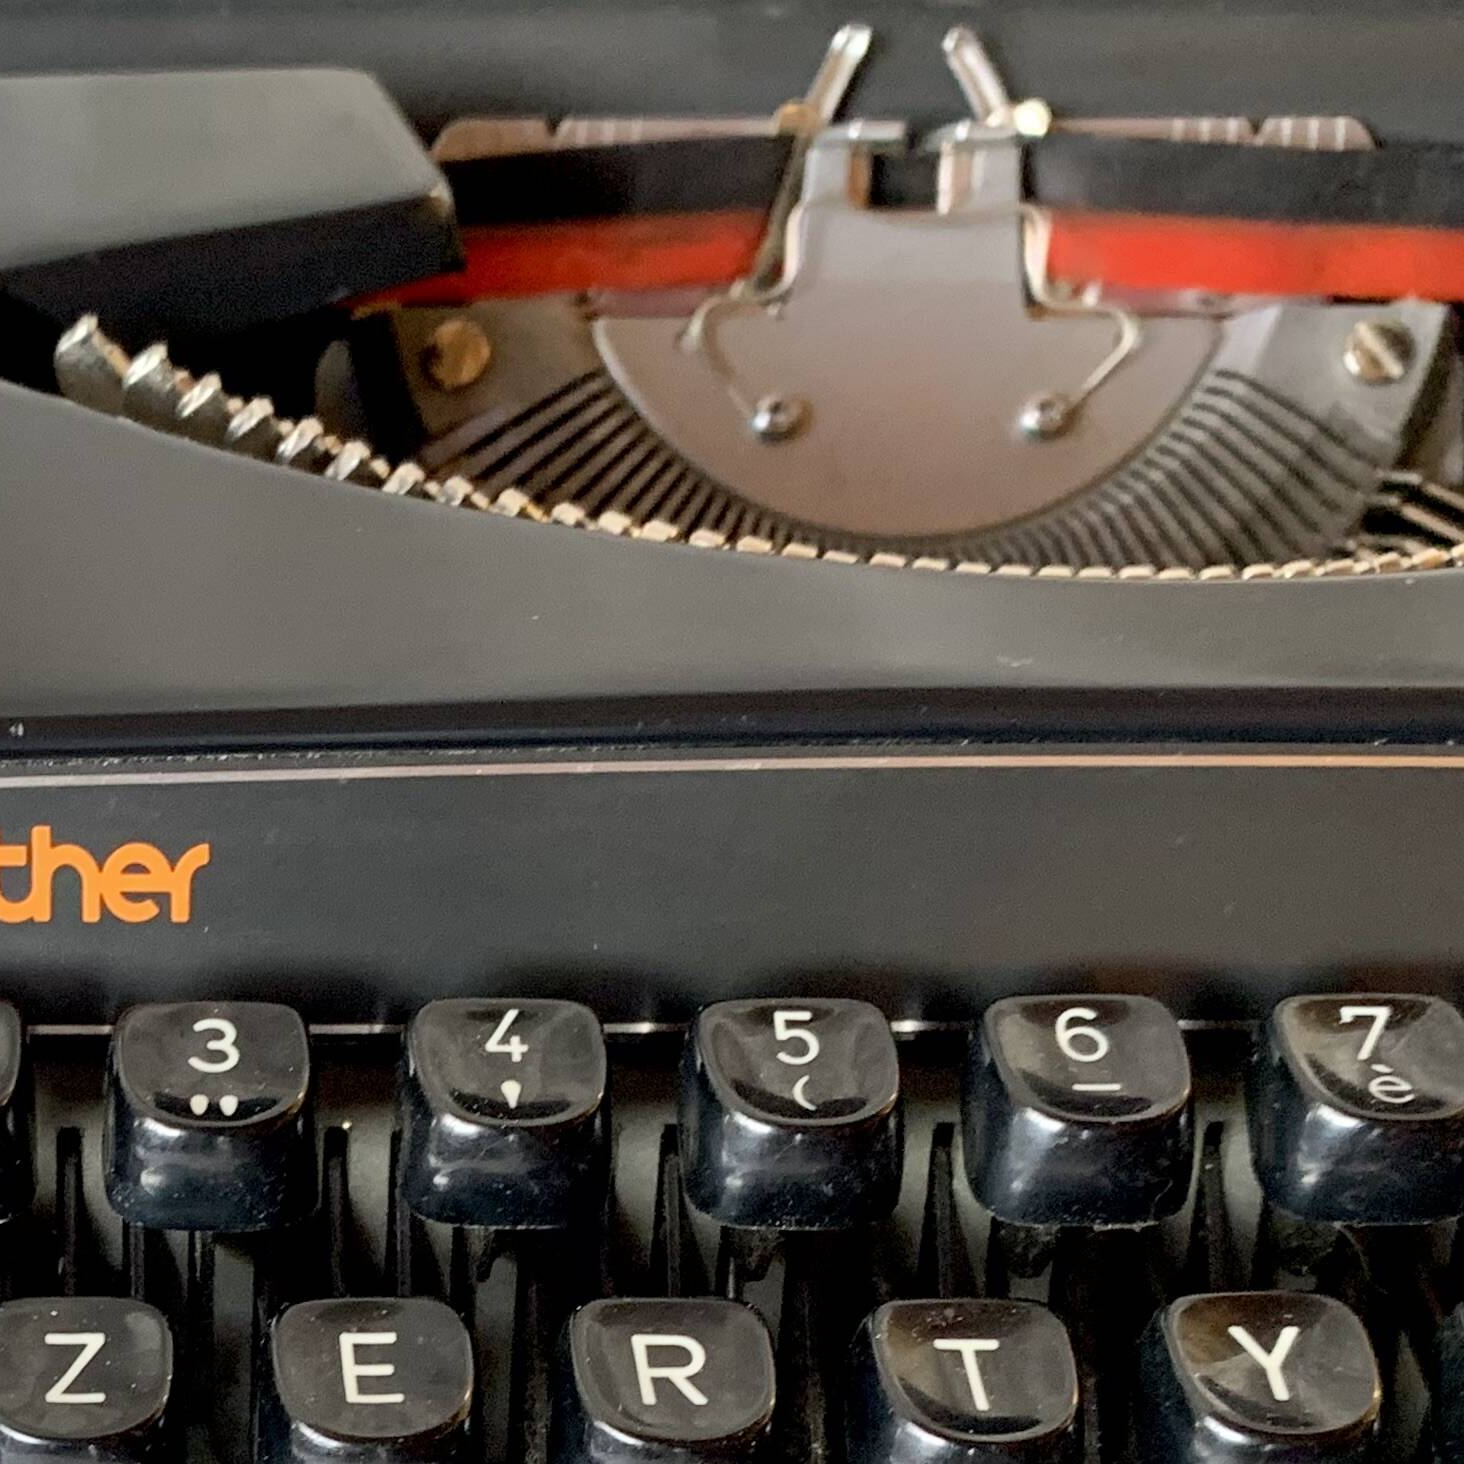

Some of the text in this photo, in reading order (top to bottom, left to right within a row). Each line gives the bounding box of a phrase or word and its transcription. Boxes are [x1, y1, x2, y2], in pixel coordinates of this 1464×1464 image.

[187, 1018, 240, 1072] 3
[484, 1009, 529, 1063] 4
[773, 1010, 821, 1065] 5
[1055, 1007, 1110, 1063] 6
[1339, 1006, 1392, 1060] 7
[1368, 1063, 1416, 1104] è
[44, 1332, 106, 1404] Z
[339, 1332, 405, 1404] E
[630, 1333, 708, 1406] R
[933, 1338, 1000, 1411] T
[1228, 1326, 1300, 1402] Y
